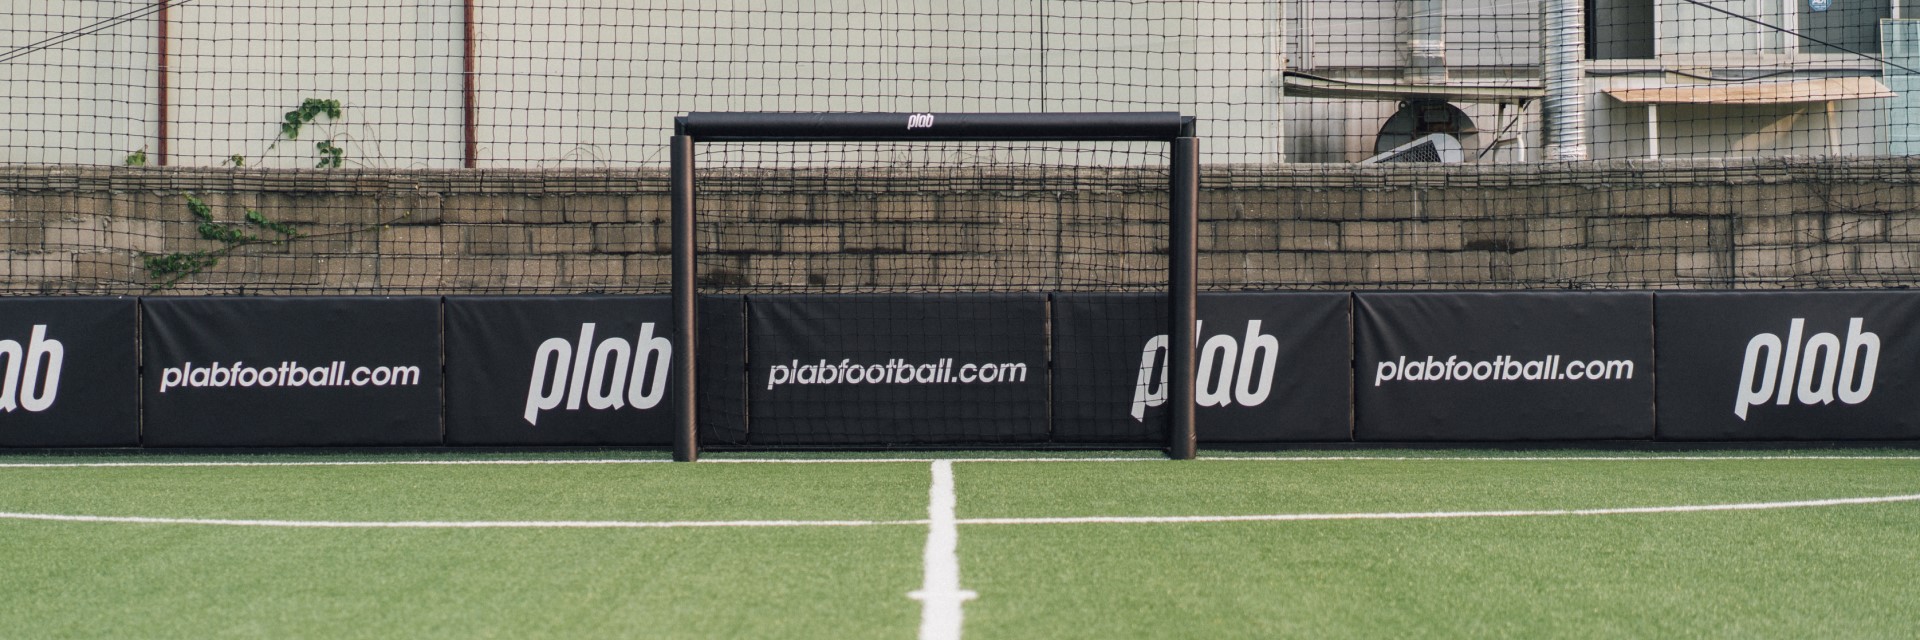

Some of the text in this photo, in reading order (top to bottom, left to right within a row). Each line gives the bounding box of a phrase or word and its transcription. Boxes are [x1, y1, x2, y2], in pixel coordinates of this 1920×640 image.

[907, 113, 934, 130] plab
[160, 360, 420, 393] plabfootball.com
[523, 322, 672, 426] plab
[767, 357, 1027, 390] plabfootball.com
[1131, 319, 1279, 423] pab
[1375, 354, 1634, 386] plabfootball.com
[1735, 317, 1880, 421] plab
